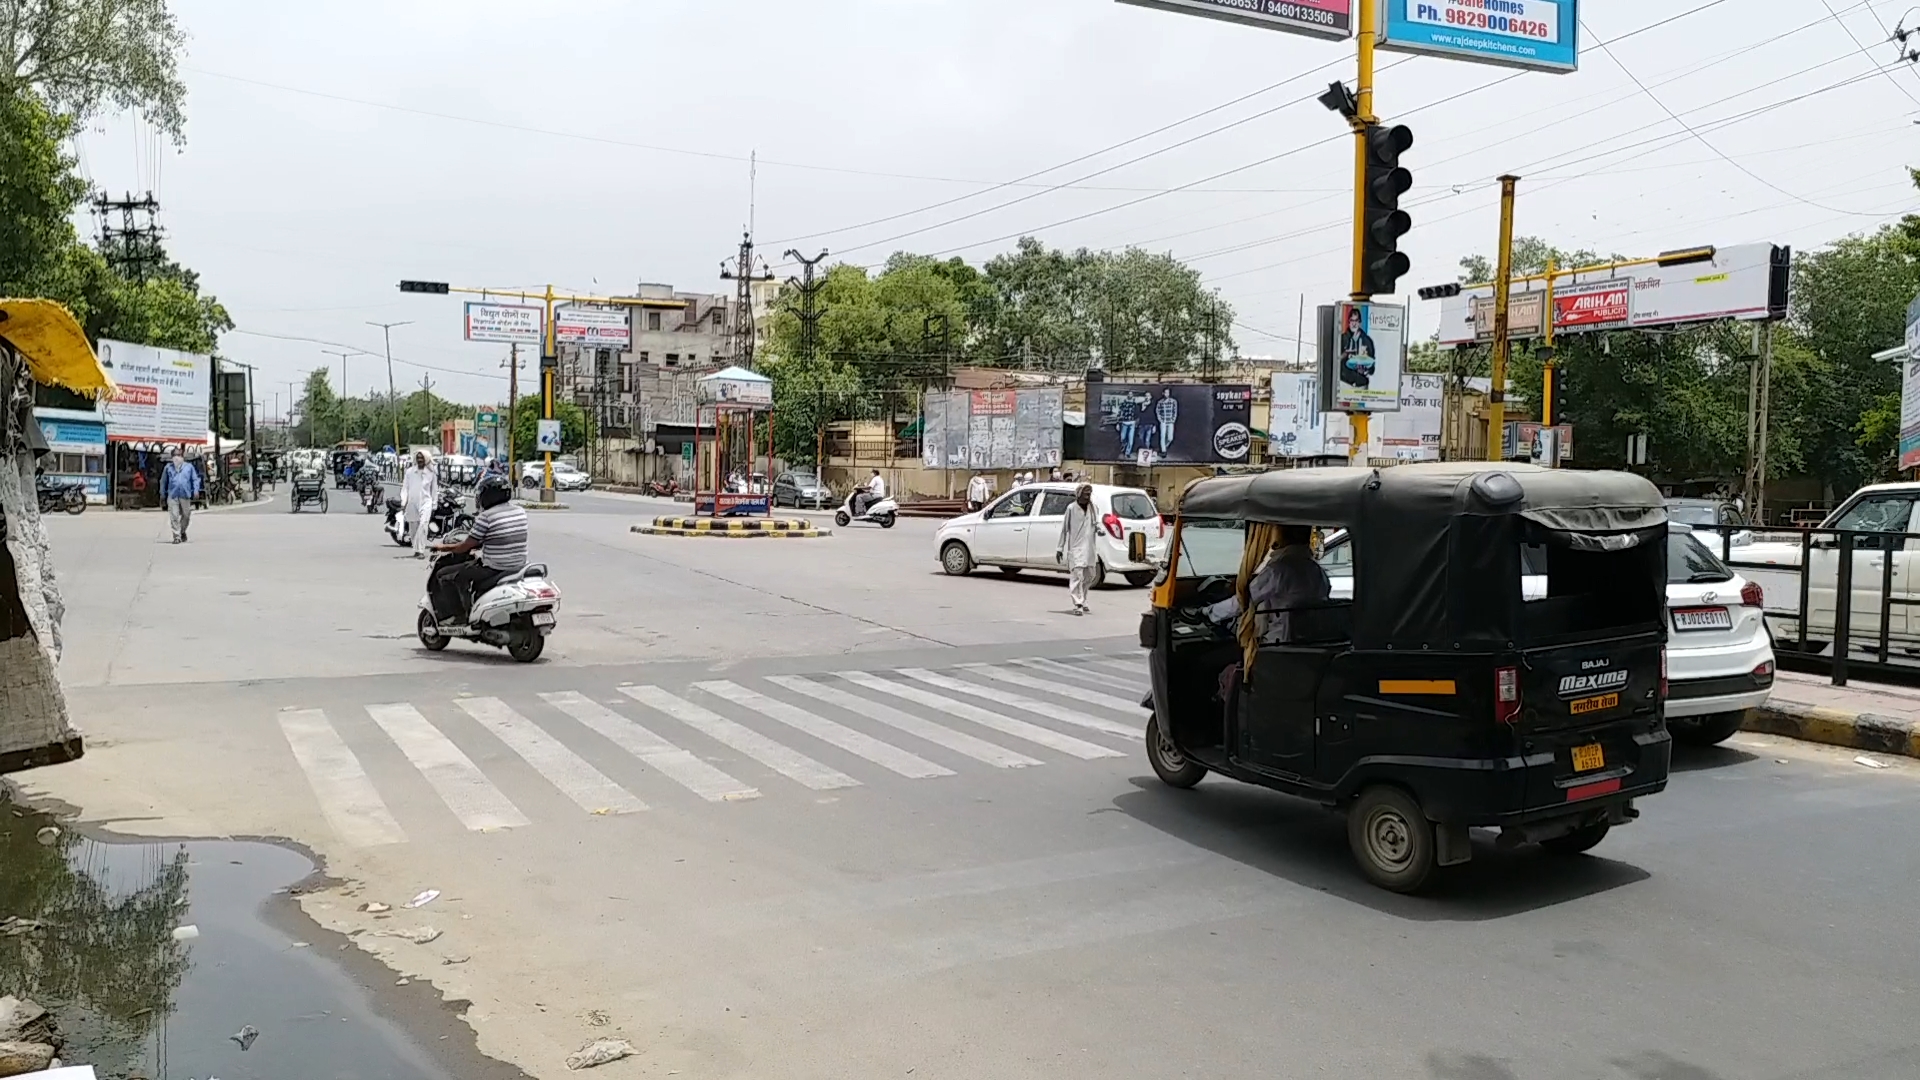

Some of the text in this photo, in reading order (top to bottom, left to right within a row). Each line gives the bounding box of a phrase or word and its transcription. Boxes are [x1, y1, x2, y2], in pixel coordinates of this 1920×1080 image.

[1268, 1, 1334, 24] 9460133506
[1418, 4, 1548, 37] Ph. 9829006426
[1431, 32, 1536, 55] www.rajdeepkitchens.com
[1572, 290, 1628, 310] ARIHANT
[1216, 390, 1241, 400] spykar
[1681, 612, 1729, 625] RJ02CE0111
[1582, 658, 1609, 670] BAJAJ
[1559, 670, 1628, 690] Maxima
[1573, 695, 1616, 712] नगरीय सेवा
